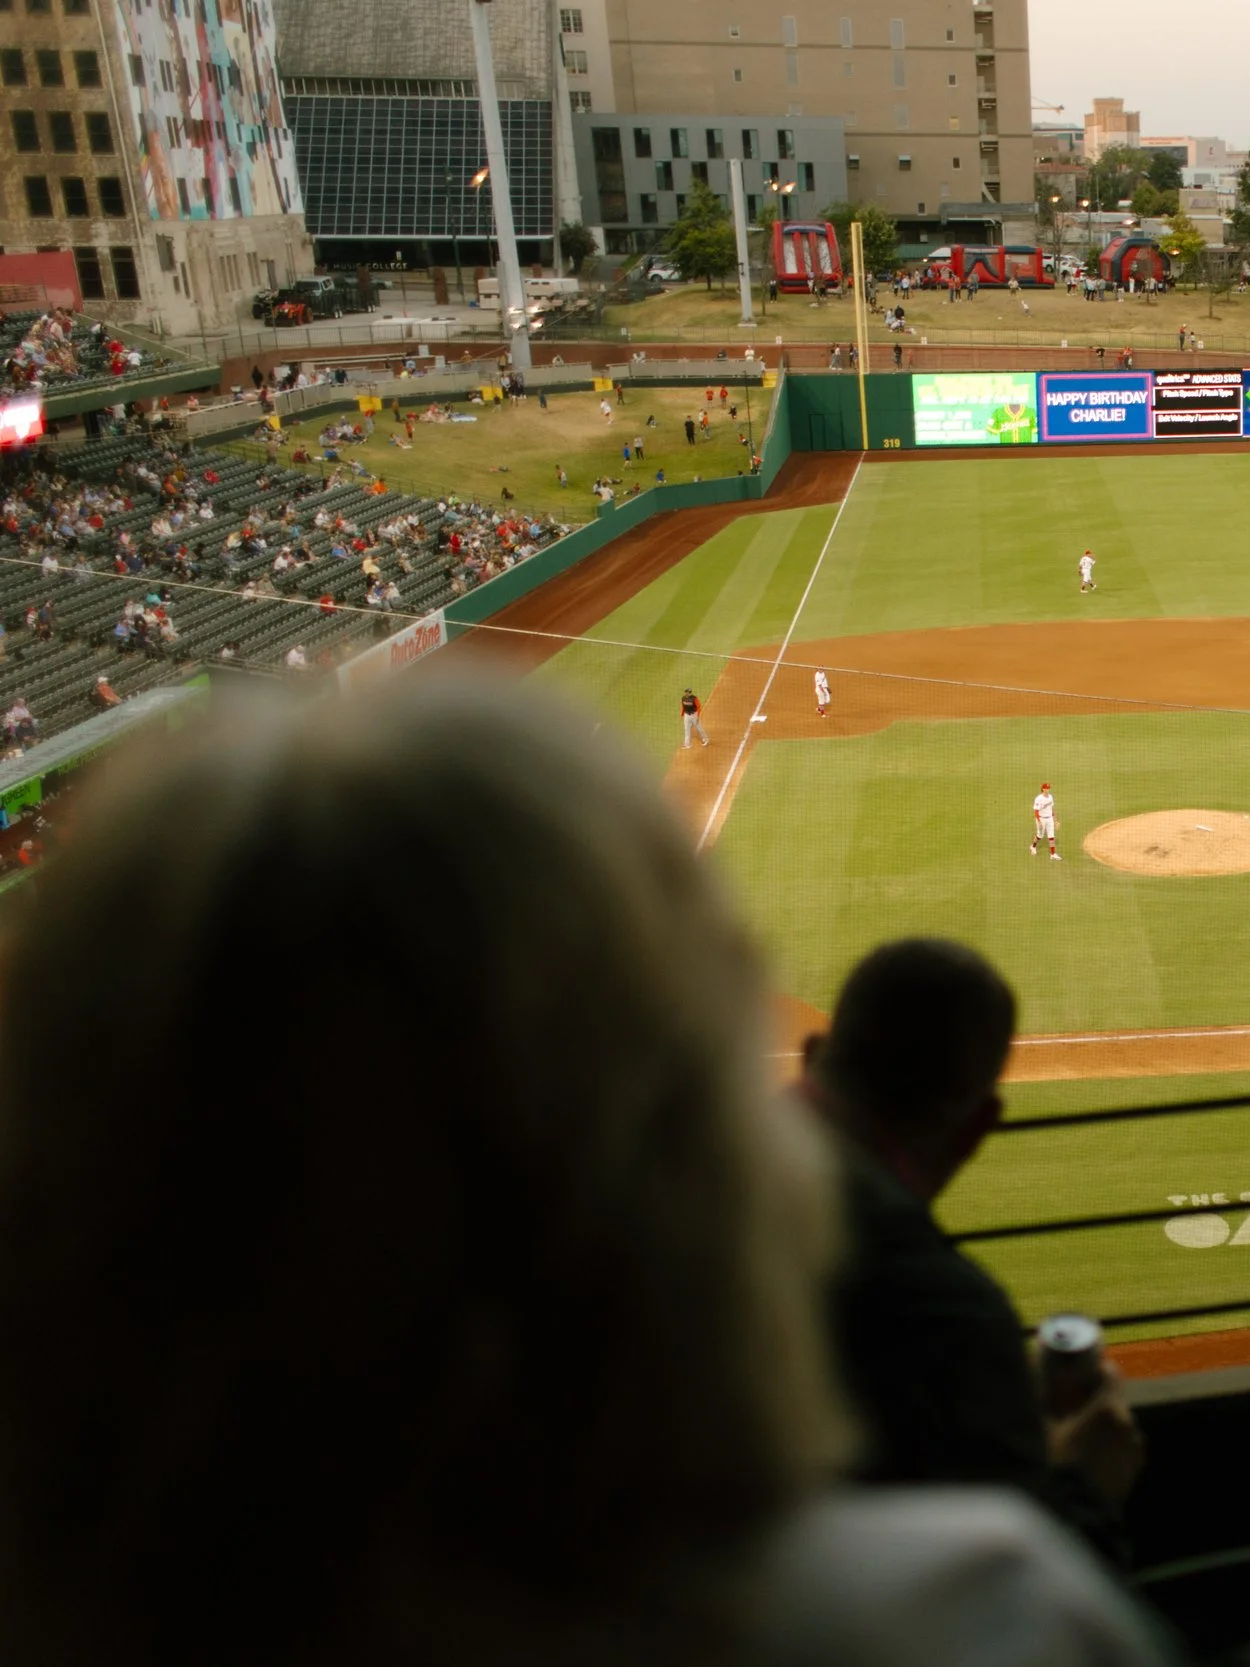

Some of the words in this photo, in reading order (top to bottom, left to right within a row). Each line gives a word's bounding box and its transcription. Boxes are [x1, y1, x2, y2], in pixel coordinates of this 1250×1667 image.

[367, 262, 408, 270] COLLEGE
[1192, 374, 1223, 384] ADVANCED
[1224, 374, 1242, 383] STATS
[1047, 392, 1088, 406] HAPPY
[1090, 391, 1148, 405] BIRTHDAY
[1070, 408, 1126, 423] CHARLIE!
[883, 438, 900, 448] 319
[1167, 1192, 1231, 1206] THE
